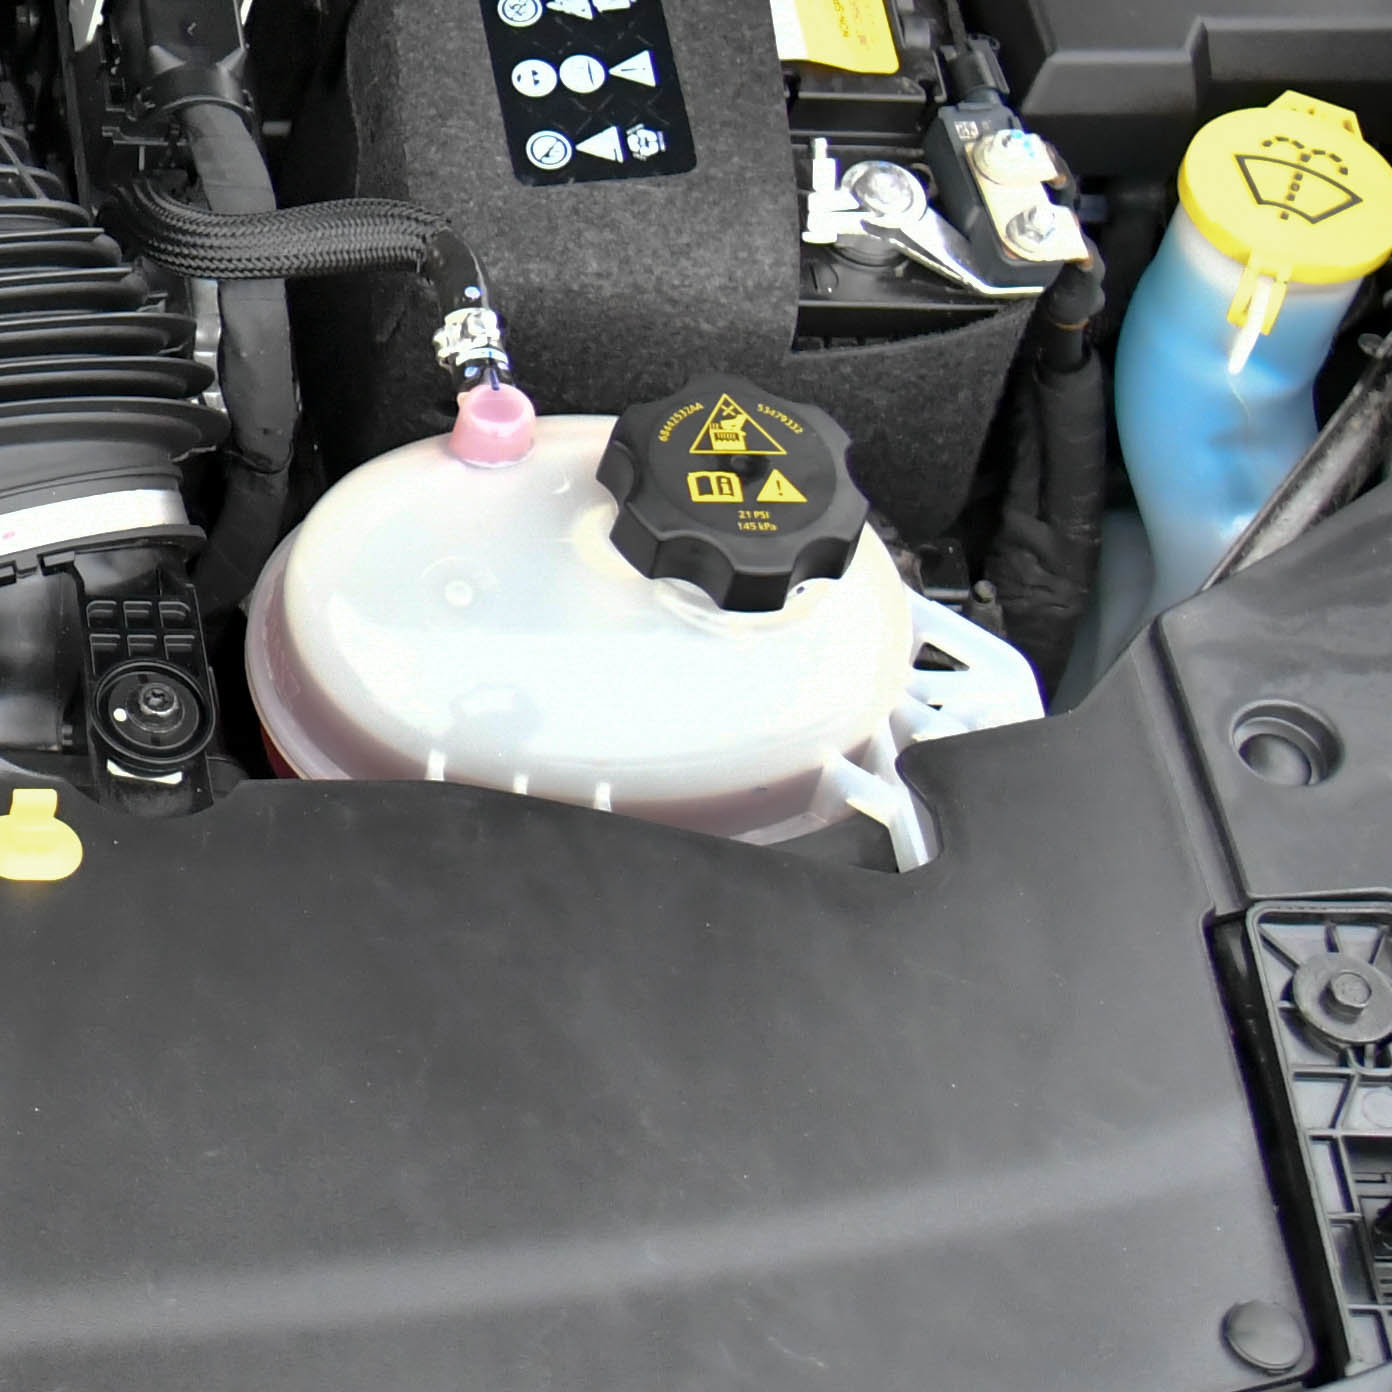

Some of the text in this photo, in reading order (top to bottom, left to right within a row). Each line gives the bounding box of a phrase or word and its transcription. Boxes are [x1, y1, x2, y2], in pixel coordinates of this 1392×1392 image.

[738, 510, 770, 520] 21 PSI
[738, 521, 777, 531] 145 kPa
